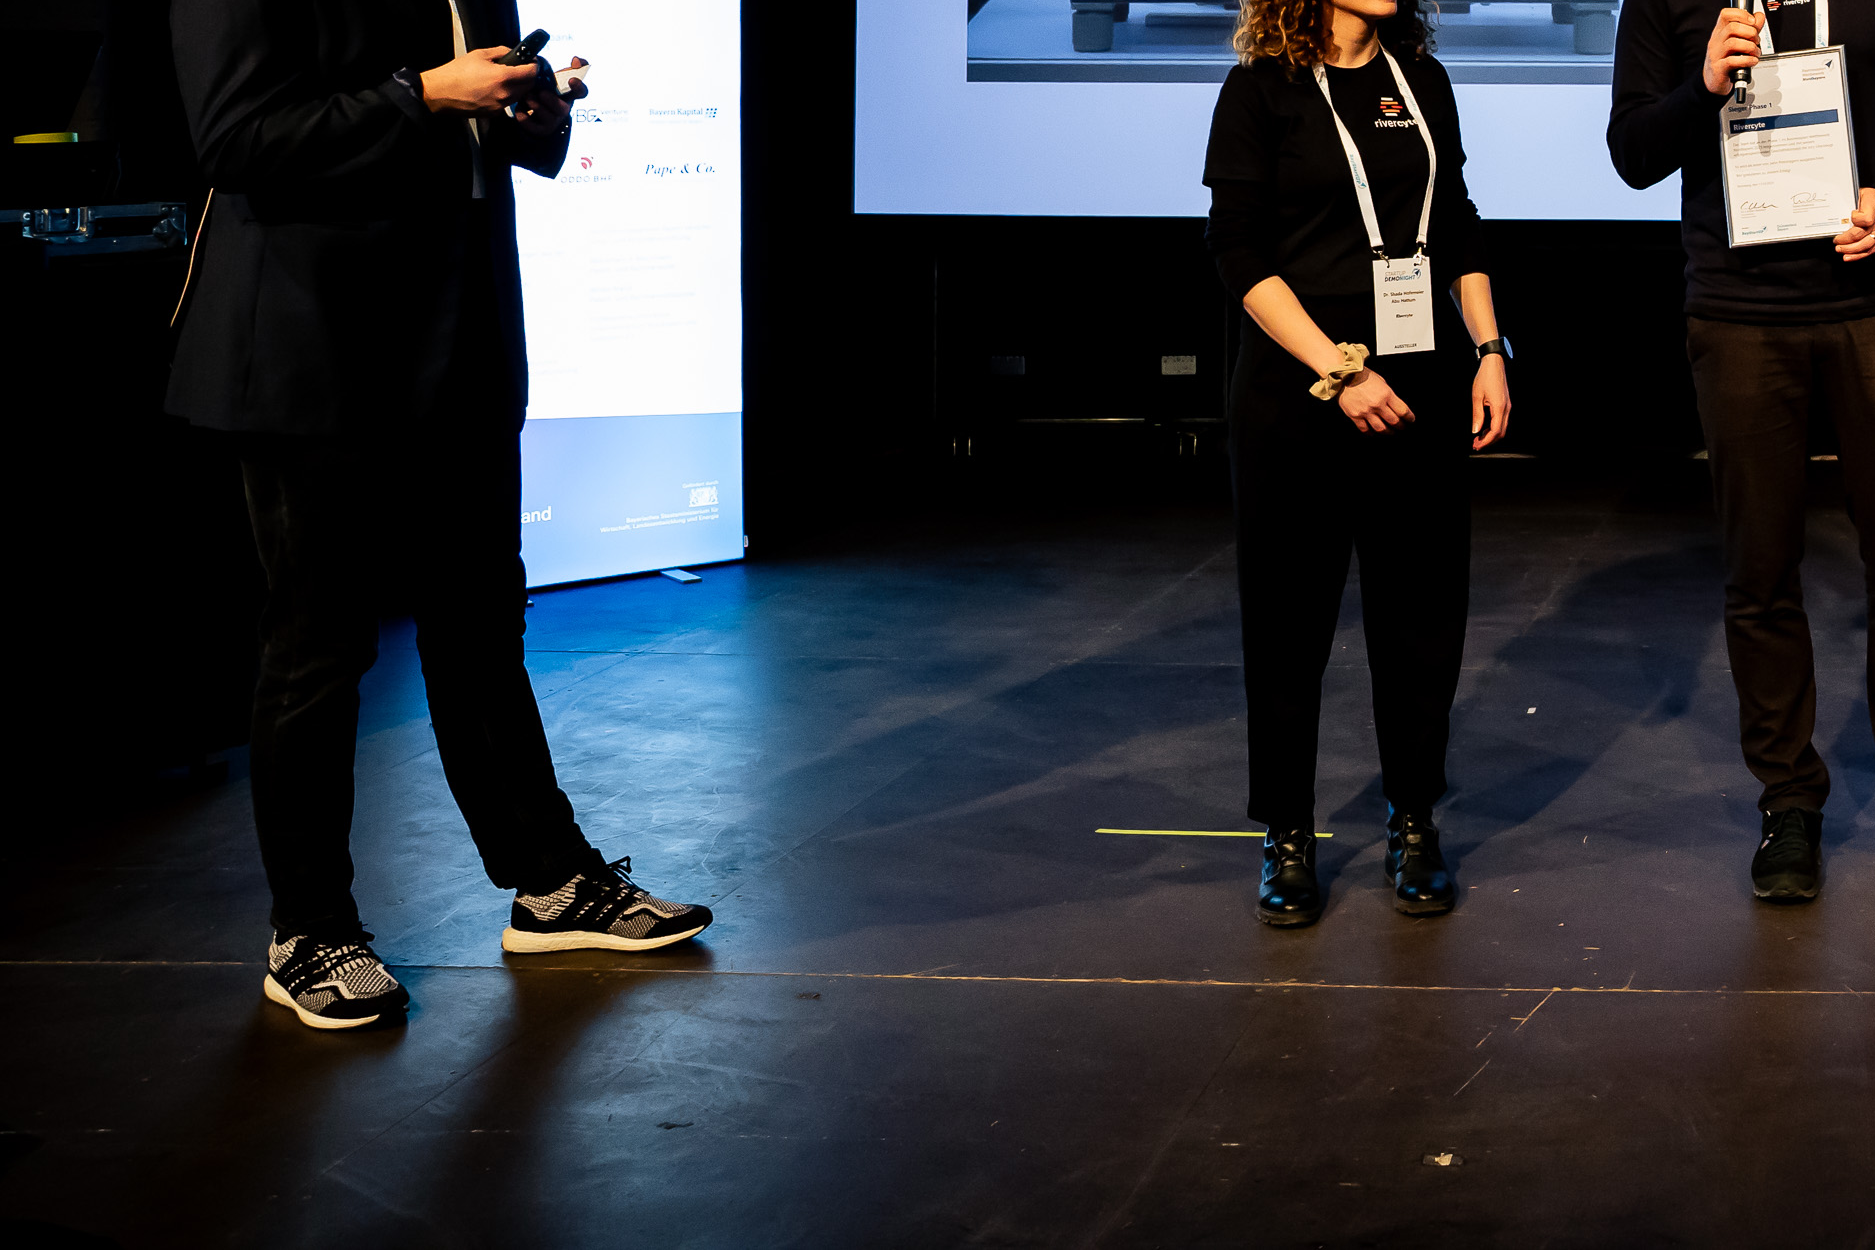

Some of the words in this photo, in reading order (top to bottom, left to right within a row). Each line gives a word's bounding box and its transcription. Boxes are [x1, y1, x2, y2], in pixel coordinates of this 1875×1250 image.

[677, 107, 704, 117] Kapital
[1733, 120, 1766, 132] Rivercyte
[645, 163, 677, 178] Pape
[680, 163, 690, 174] &
